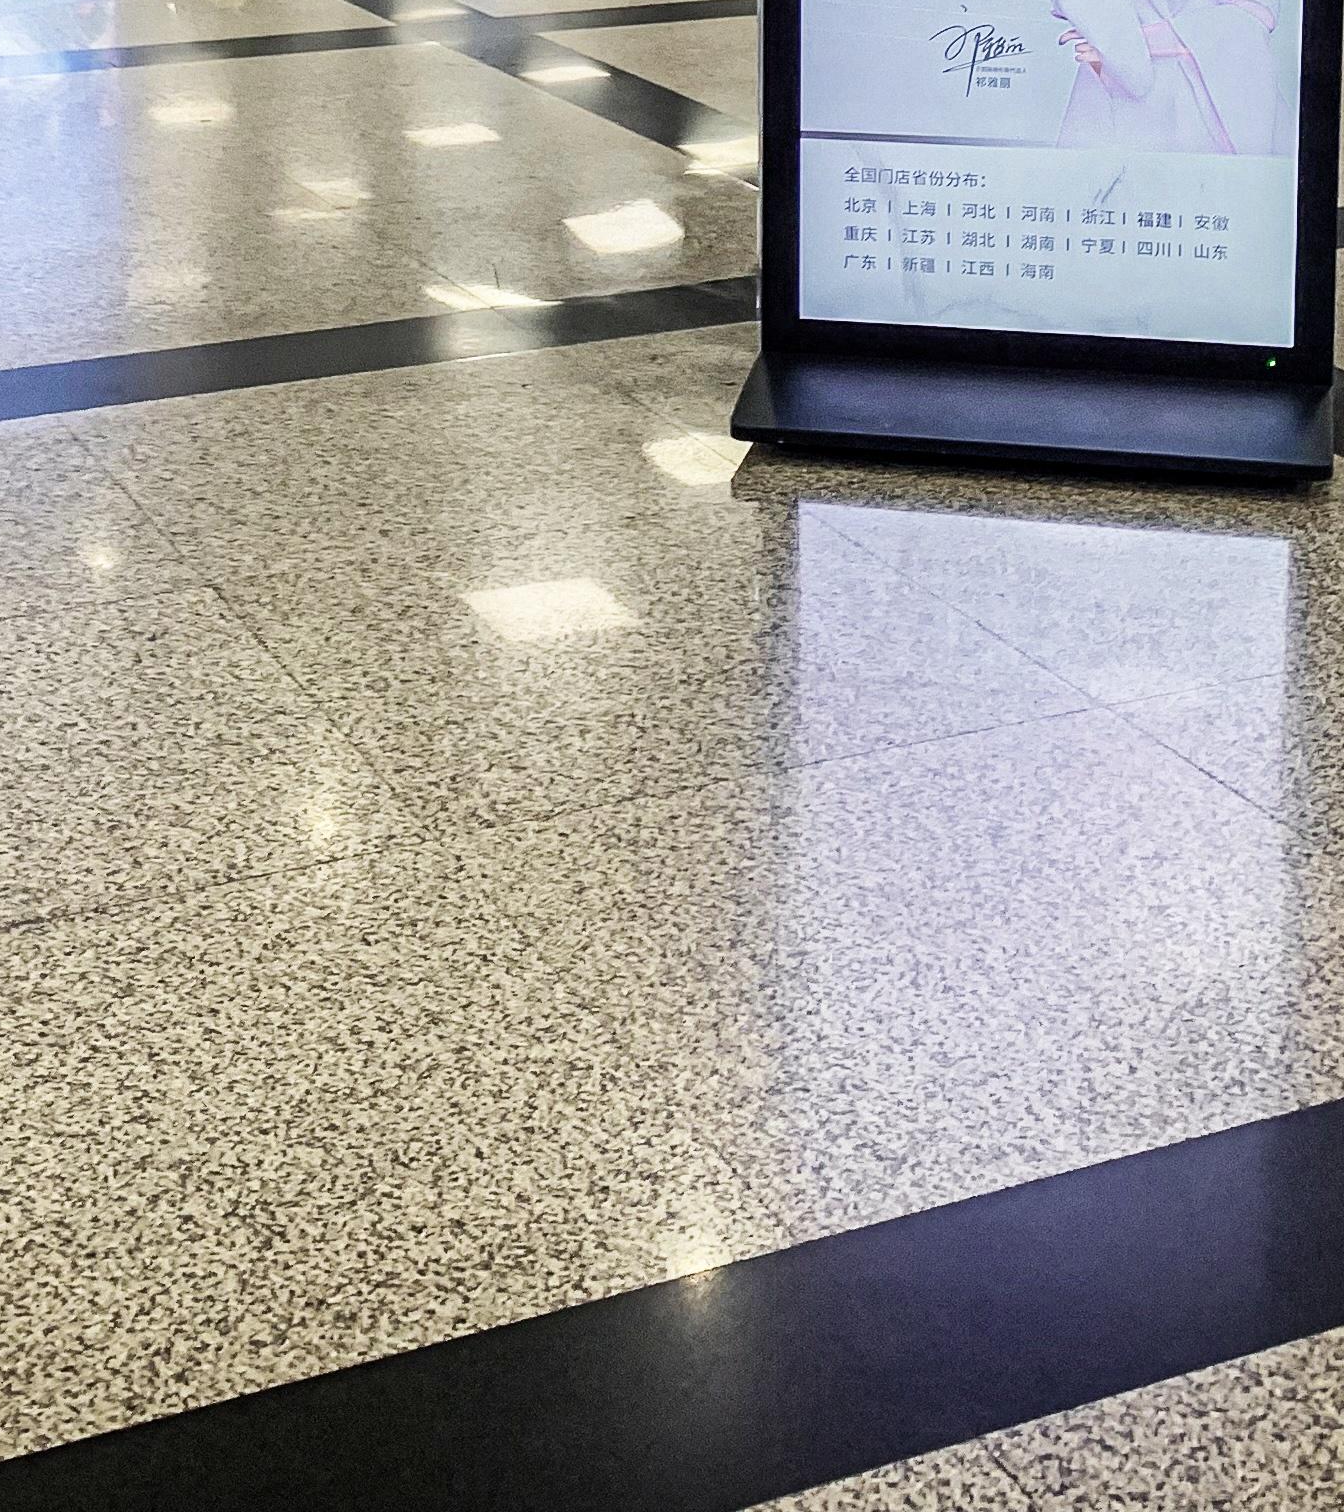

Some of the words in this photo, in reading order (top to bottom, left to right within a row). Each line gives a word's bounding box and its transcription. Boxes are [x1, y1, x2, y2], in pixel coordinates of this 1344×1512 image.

[844, 197, 877, 213] 北京
[903, 201, 936, 216] 上海
[962, 203, 996, 219] 河北
[1021, 206, 1054, 223] 河南
[1082, 209, 1115, 225] 浙江
[1138, 212, 1172, 228] 福建
[1194, 215, 1229, 231] 安徽
[844, 226, 877, 242] 重庆
[902, 228, 936, 245] 江苏
[962, 231, 996, 248] 湖北
[1021, 235, 1054, 252] 湖南
[1082, 238, 1115, 255] 宁夏
[1138, 241, 1171, 257] 四川
[1194, 244, 1227, 260] 山东
[844, 255, 877, 270] 广东
[962, 259, 994, 276] 江西
[1021, 263, 1054, 280] 海南
